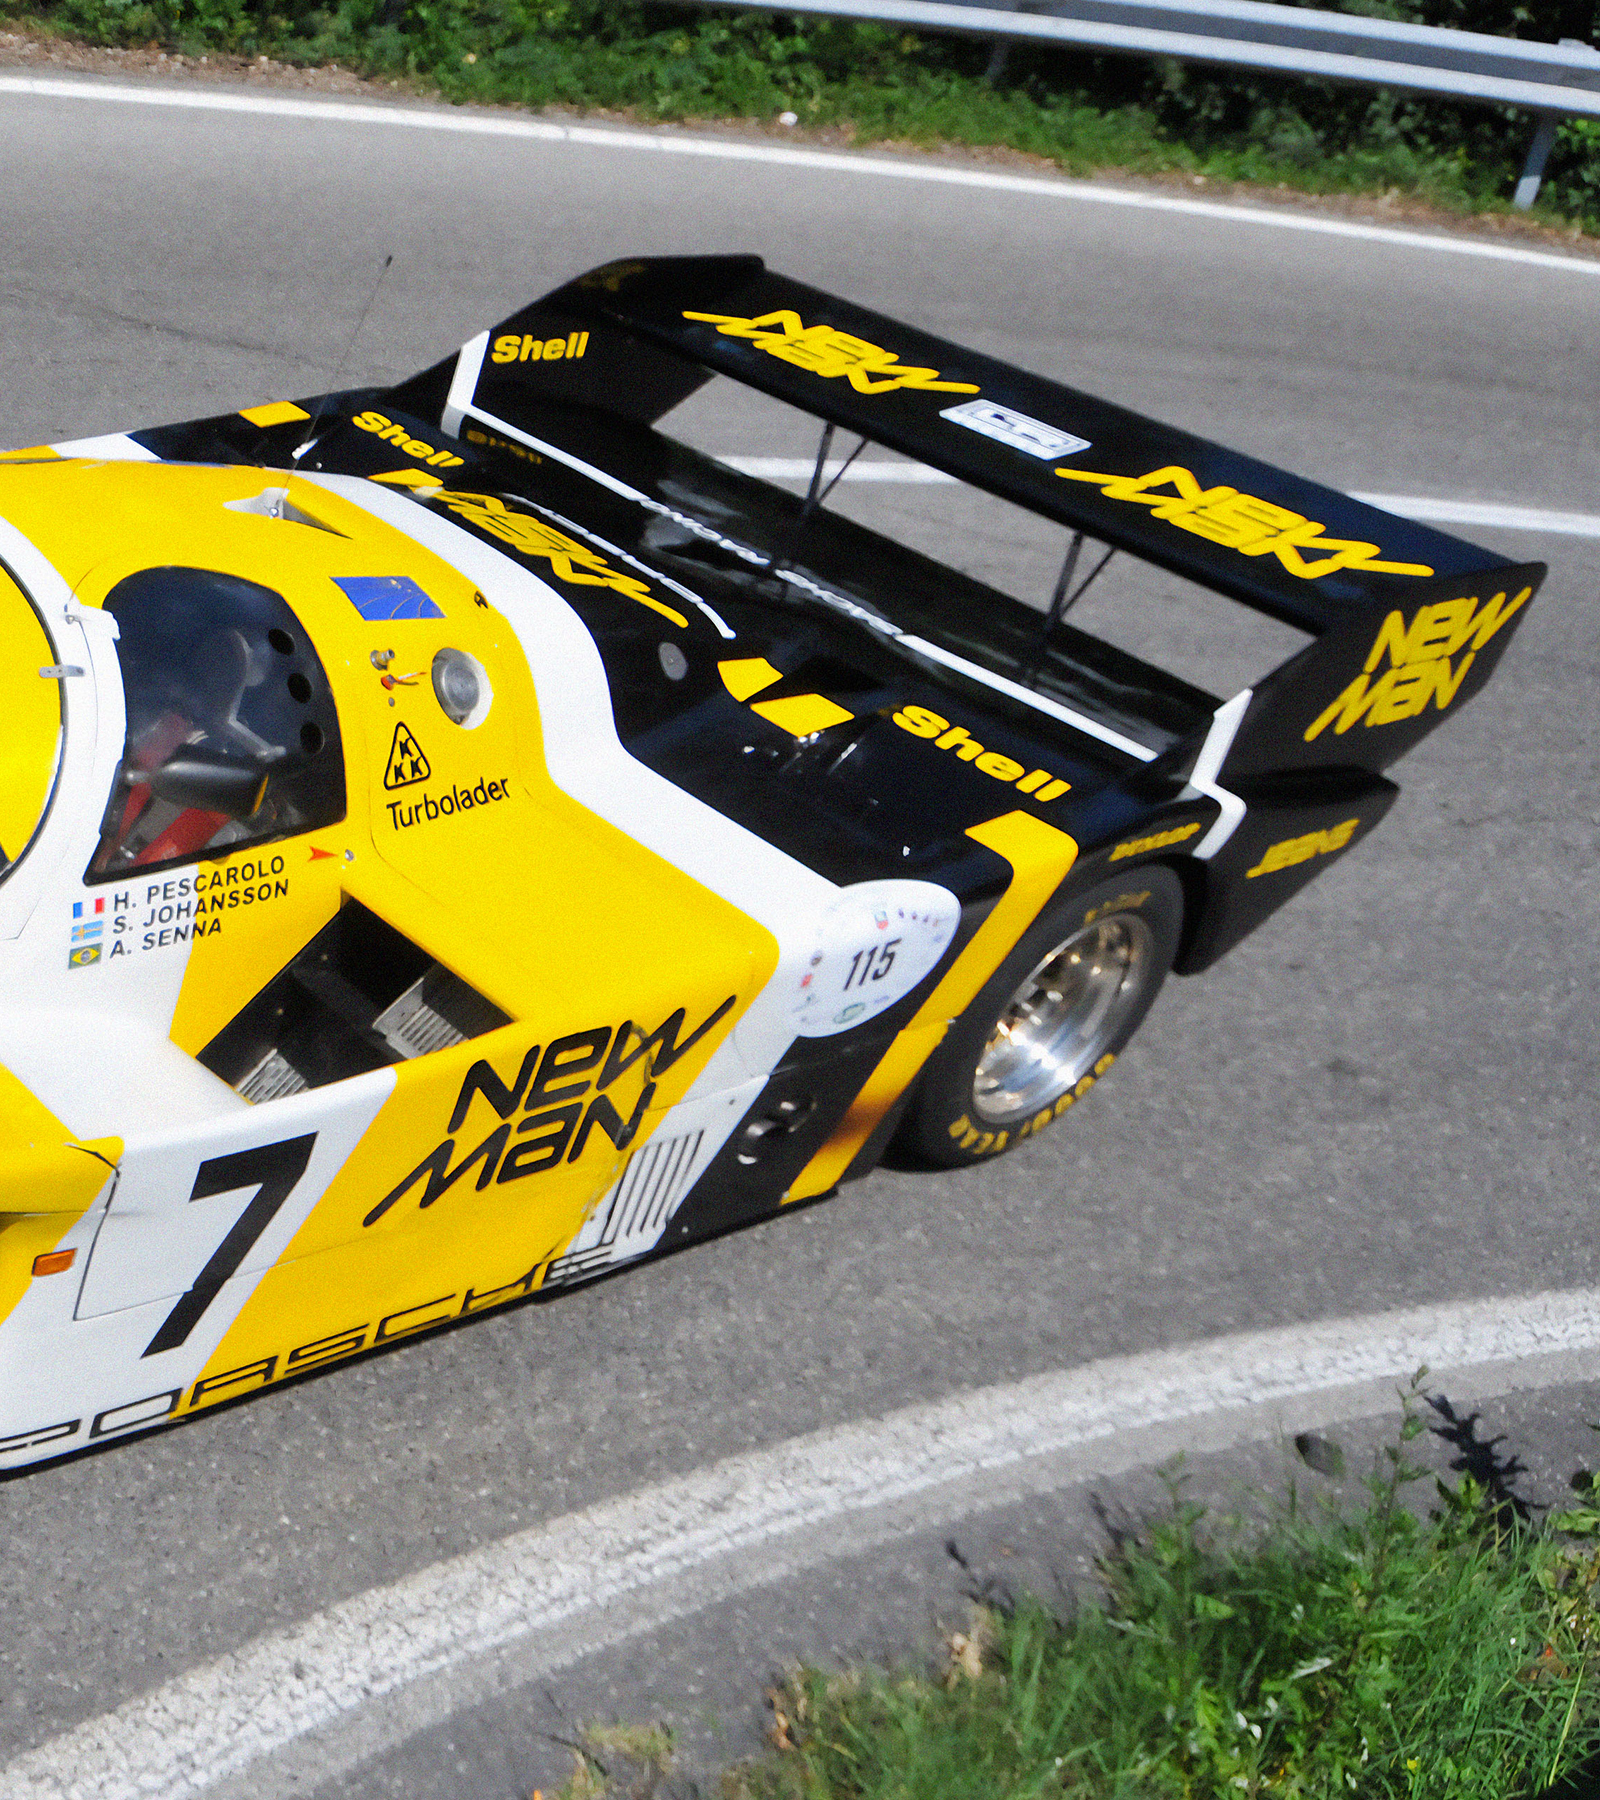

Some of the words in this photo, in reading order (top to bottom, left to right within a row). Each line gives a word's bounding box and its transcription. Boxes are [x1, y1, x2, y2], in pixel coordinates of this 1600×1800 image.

[491, 331, 590, 364] Shell
[352, 410, 465, 468] Shell
[892, 705, 1072, 803] Shell
[386, 777, 510, 831] Turbolader
[113, 915, 133, 935] S.
[143, 879, 289, 929] JOHANSSON
[114, 891, 137, 912] H.
[146, 855, 285, 905] PESCAROLO
[109, 940, 132, 960] A.
[141, 918, 222, 951] SENNA
[843, 937, 902, 991] 115
[140, 1131, 319, 1359] 7
